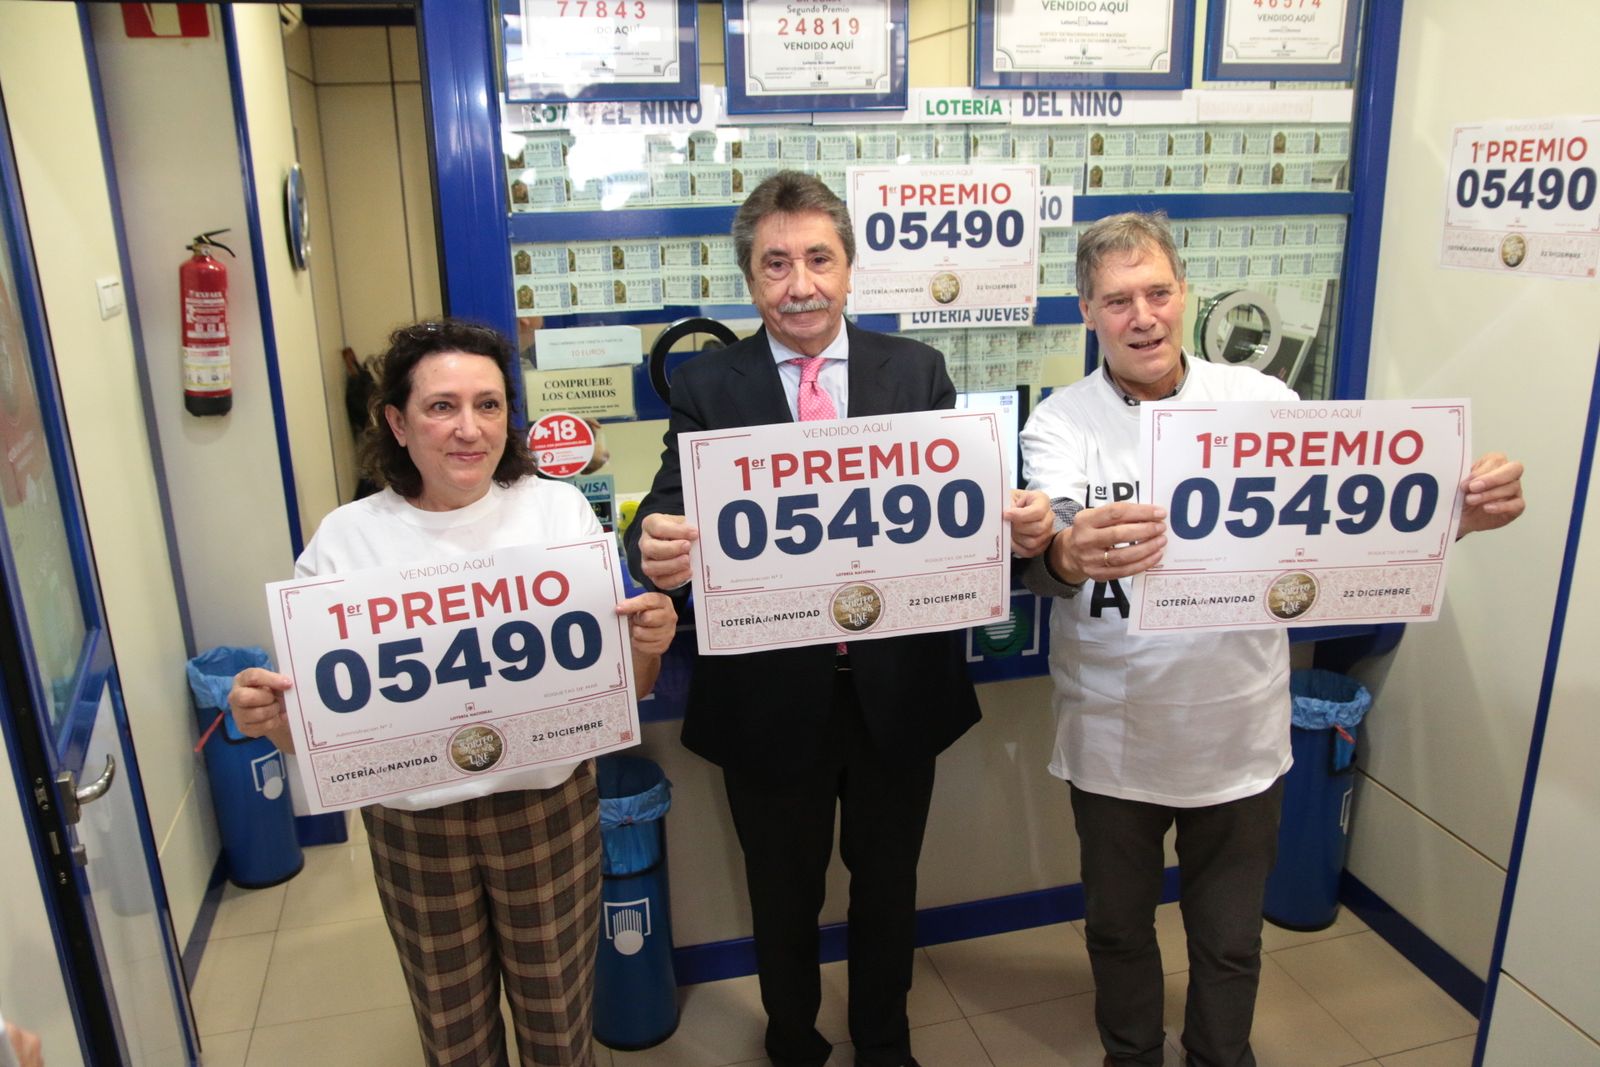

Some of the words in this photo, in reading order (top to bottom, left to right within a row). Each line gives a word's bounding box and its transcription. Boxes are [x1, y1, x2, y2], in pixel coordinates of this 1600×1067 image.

[557, 1, 646, 19] 77843
[786, 5, 820, 16] Segundo
[822, 5, 850, 14] Premio
[1042, 0, 1096, 12] VENDIDO
[1099, 0, 1129, 14] AQUÍ
[777, 17, 860, 36] 24819
[1258, 13, 1294, 23] VENDIDO
[1295, 13, 1316, 23] AQUÍ
[784, 42, 828, 51] VENDIDO
[830, 41, 854, 51] AQUÍ
[925, 96, 1003, 116] LOTERÍA
[1022, 91, 1063, 117] DEL
[1486, 136, 1588, 163] PREMIO
[900, 183, 1012, 207] PREMIO
[1456, 166, 1598, 211] 05490
[865, 209, 1024, 252] 05490
[976, 307, 1029, 322] JUEVES
[544, 377, 613, 389] COMPRUEBE
[542, 391, 563, 401] LOS
[566, 389, 616, 400] CAMBIOS
[1270, 408, 1328, 420] VENDIDO
[1330, 405, 1362, 420] AQUÍ
[802, 424, 860, 440] VENDIDO
[862, 421, 893, 435] AQUÍ
[1196, 431, 1229, 469] 1er
[1232, 429, 1424, 469] PREMIO
[734, 456, 767, 491] 1er
[771, 438, 960, 489] PREMIO
[579, 482, 608, 493] VISA
[1169, 472, 1439, 541] 05490
[717, 478, 986, 561] 05490
[399, 562, 460, 581] VENDIDO
[463, 555, 495, 572] AQUÍ
[923, 592, 977, 605] DICIEMBRE
[1156, 596, 1197, 607] LOTERÍA
[1209, 594, 1256, 604] NAVIDAD
[1357, 587, 1411, 597] DICIEMBRE
[328, 602, 363, 641] 1er
[368, 570, 570, 635] PREMIO
[720, 615, 762, 627] LOTERÍA
[774, 609, 820, 621] NAVIDAD
[315, 610, 603, 714] 05490
[532, 733, 545, 742] 22
[547, 720, 604, 739] DICIEMBRE
[331, 766, 376, 783] LOTERÍA
[387, 755, 438, 772] NAVIDAD
